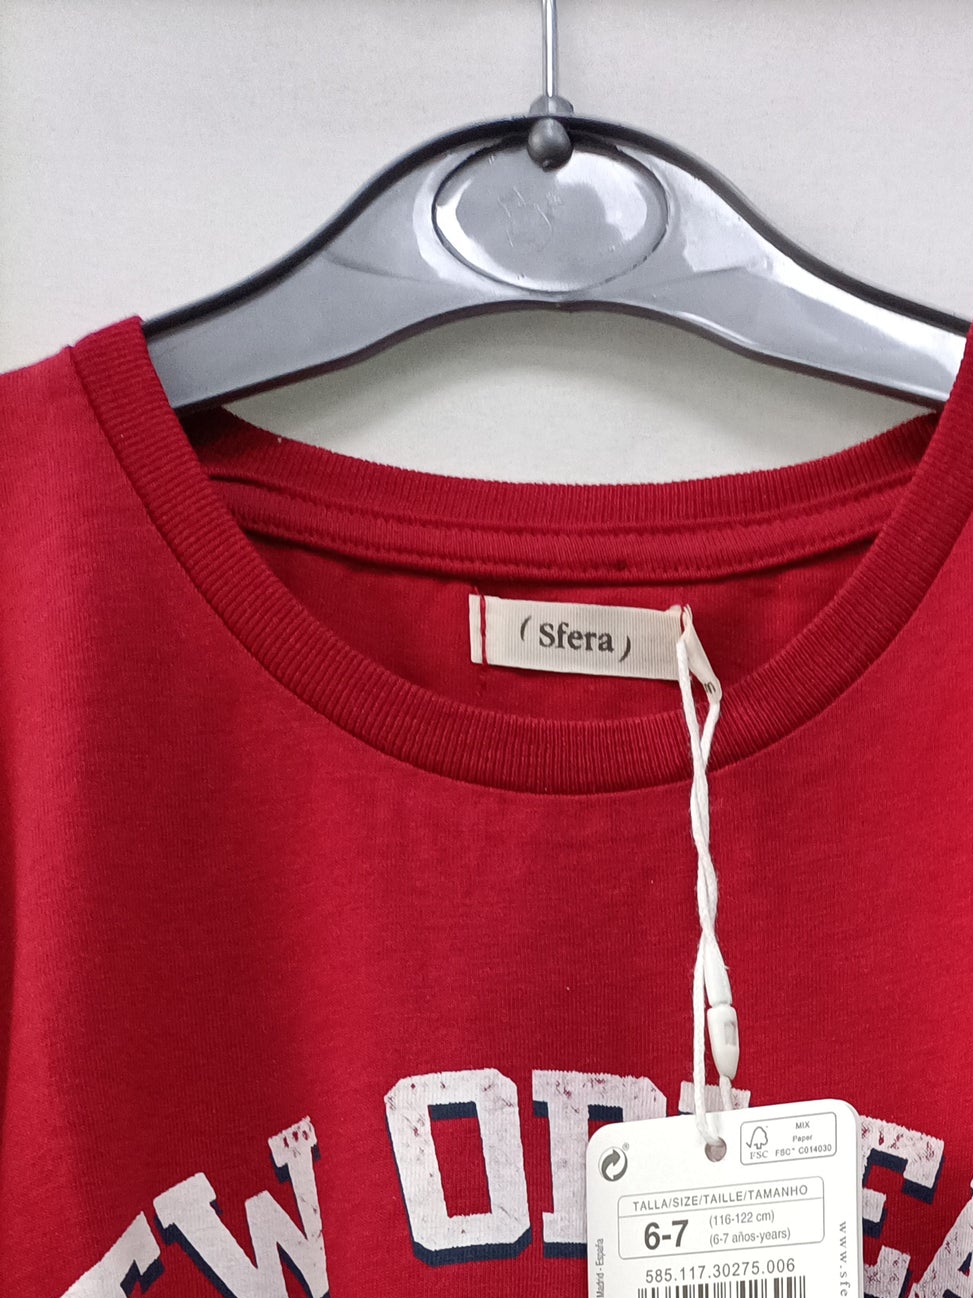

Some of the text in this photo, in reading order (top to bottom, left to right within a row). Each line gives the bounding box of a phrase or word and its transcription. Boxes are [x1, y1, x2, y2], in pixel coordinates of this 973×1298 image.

[795, 1120, 810, 1129] MIX
[792, 1134, 813, 1143] Paper
[798, 1143, 833, 1155] C014030
[750, 1150, 769, 1160] FSC
[632, 1185, 808, 1212] TALLA/SIZE/TAILLE/TAMANHO
[708, 1210, 775, 1228] (116-122 cm)
[643, 1219, 689, 1251] 6-7
[709, 1227, 791, 1248] (6-7 años-years)
[595, 1238, 605, 1266] España
[645, 1257, 796, 1283] 585.117.30275.006
[596, 1272, 605, 1298] Madrid
